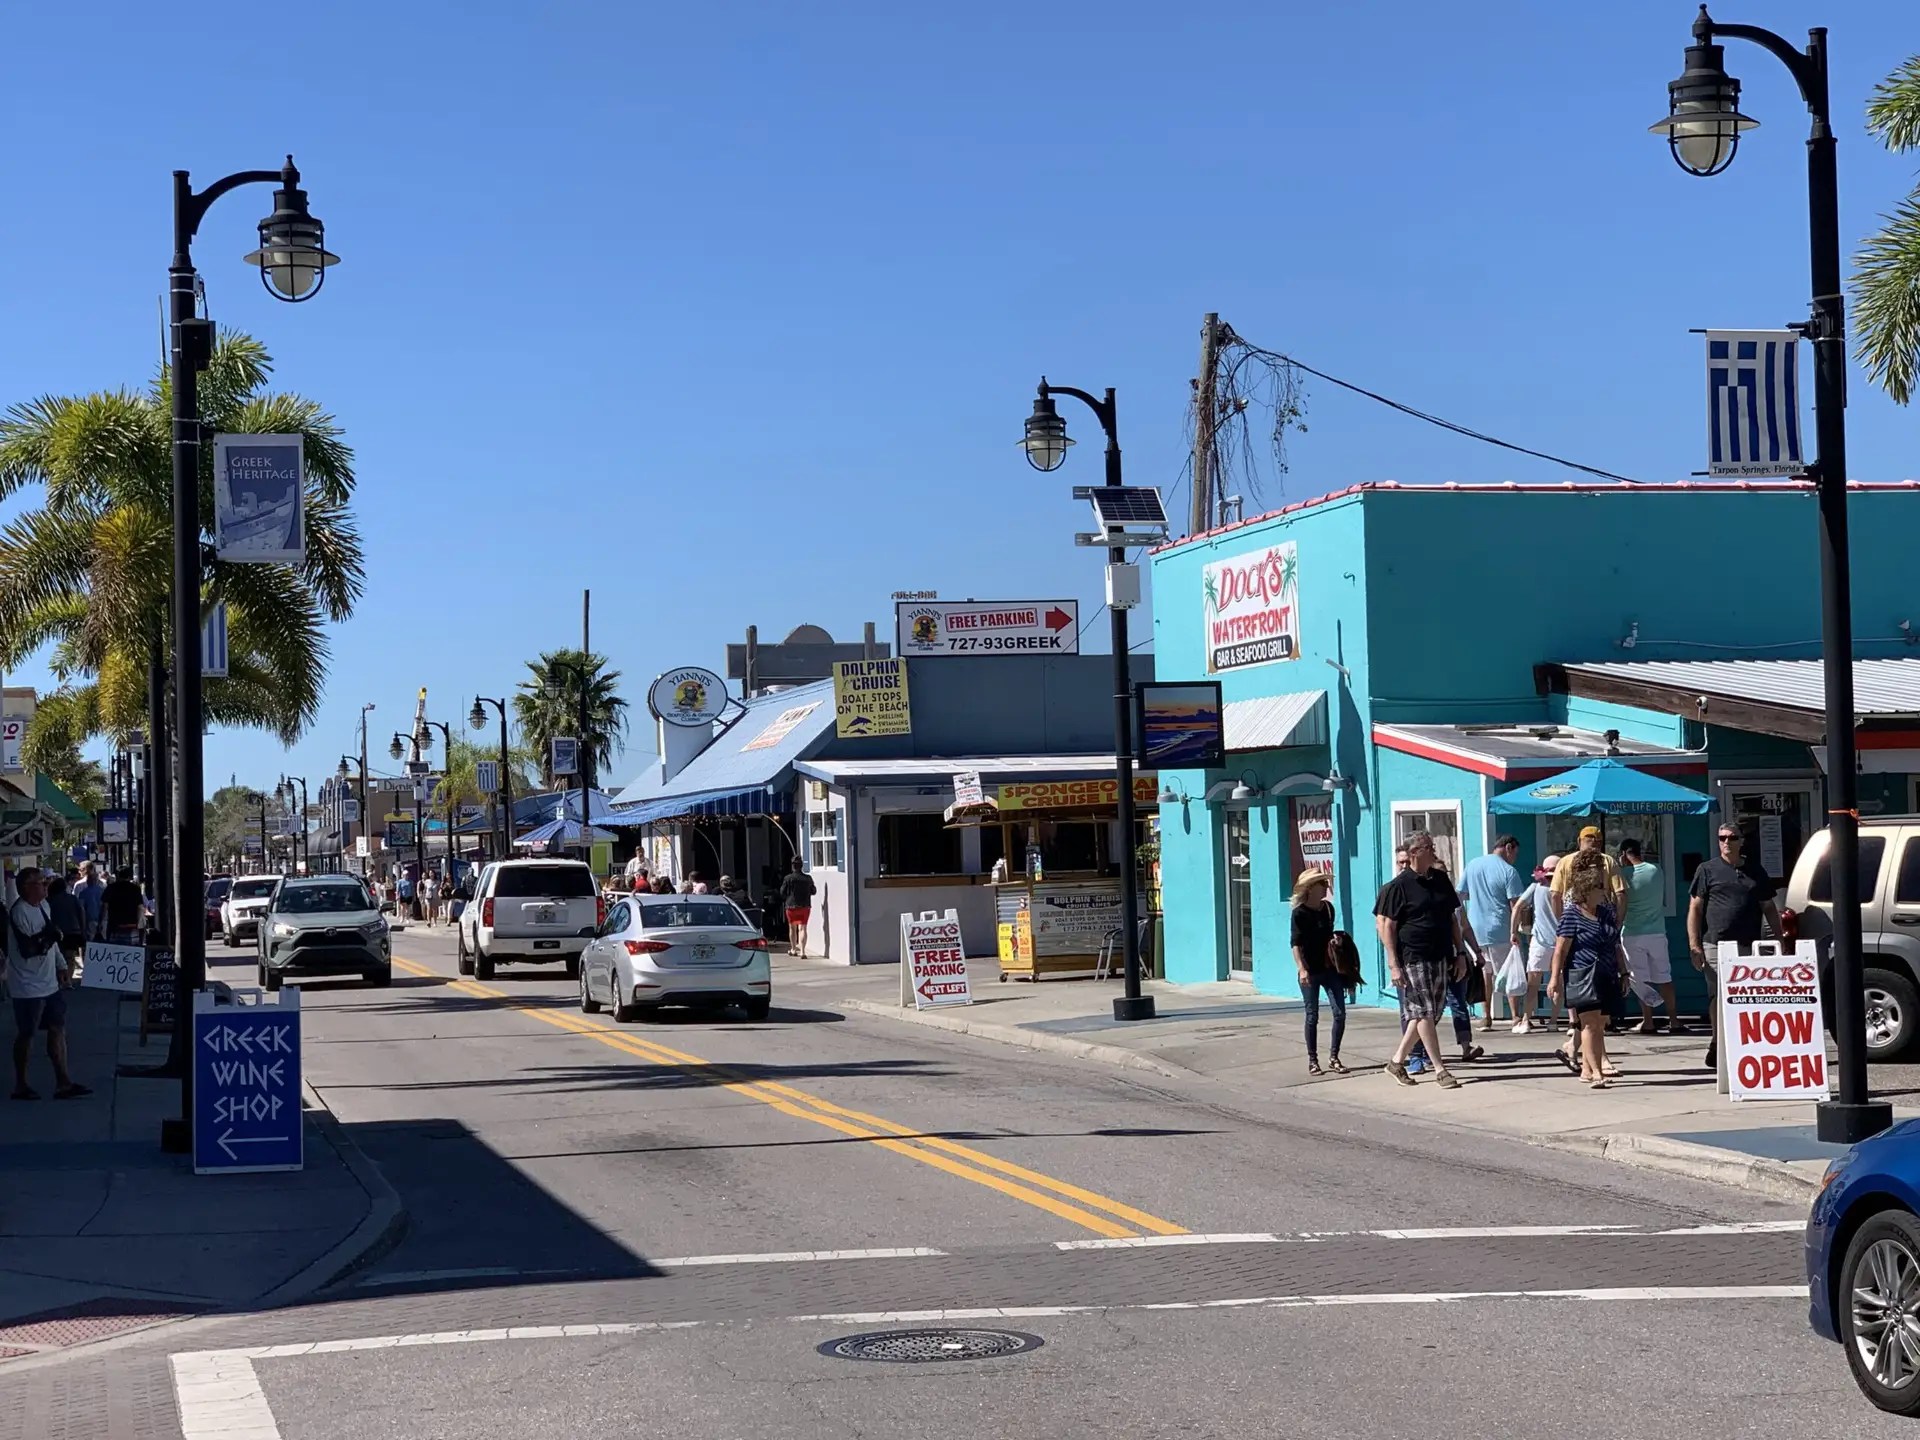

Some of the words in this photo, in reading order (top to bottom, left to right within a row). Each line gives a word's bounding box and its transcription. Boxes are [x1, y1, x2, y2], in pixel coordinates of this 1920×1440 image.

[231, 456, 273, 468] GREEK
[1713, 466, 1739, 474] Tarpon
[1774, 465, 1801, 473] Florida
[232, 468, 296, 480] HERITAGE
[948, 615, 978, 630] FREE
[980, 611, 1035, 628] PARKING
[1212, 606, 1290, 646] WATERFRONT
[949, 636, 1062, 650] 727-93GREEK
[1216, 648, 1230, 667] BAR
[1230, 647, 1236, 665] &
[1236, 642, 1268, 663] SEAFOOD
[1267, 639, 1289, 659] GRILL
[841, 661, 900, 677] DOLPHIN
[852, 675, 901, 690] CRUISE
[842, 694, 867, 704] BOAT
[871, 692, 902, 702] STOPS
[837, 705, 851, 714] ON
[856, 703, 874, 713] THE
[879, 701, 908, 712] BEACH
[1022, 794, 1100, 808] CRUISE
[1609, 803, 1628, 811] ONE
[1632, 803, 1651, 811] LIFE
[1095, 894, 1121, 902] CRUIS
[910, 937, 960, 945] WATERFRONT
[89, 947, 142, 963] WATER
[913, 949, 962, 964] FREE
[914, 962, 966, 978] PARKING
[924, 985, 945, 994] NEXT
[946, 983, 965, 993] LEFT
[1727, 985, 1816, 996] WATERFRONT
[1739, 1011, 1814, 1045] NOW
[203, 1025, 292, 1053] GREEK
[211, 1059, 284, 1091] WINE
[1738, 1054, 1824, 1089] OPEN
[213, 1093, 283, 1123] SHOP
